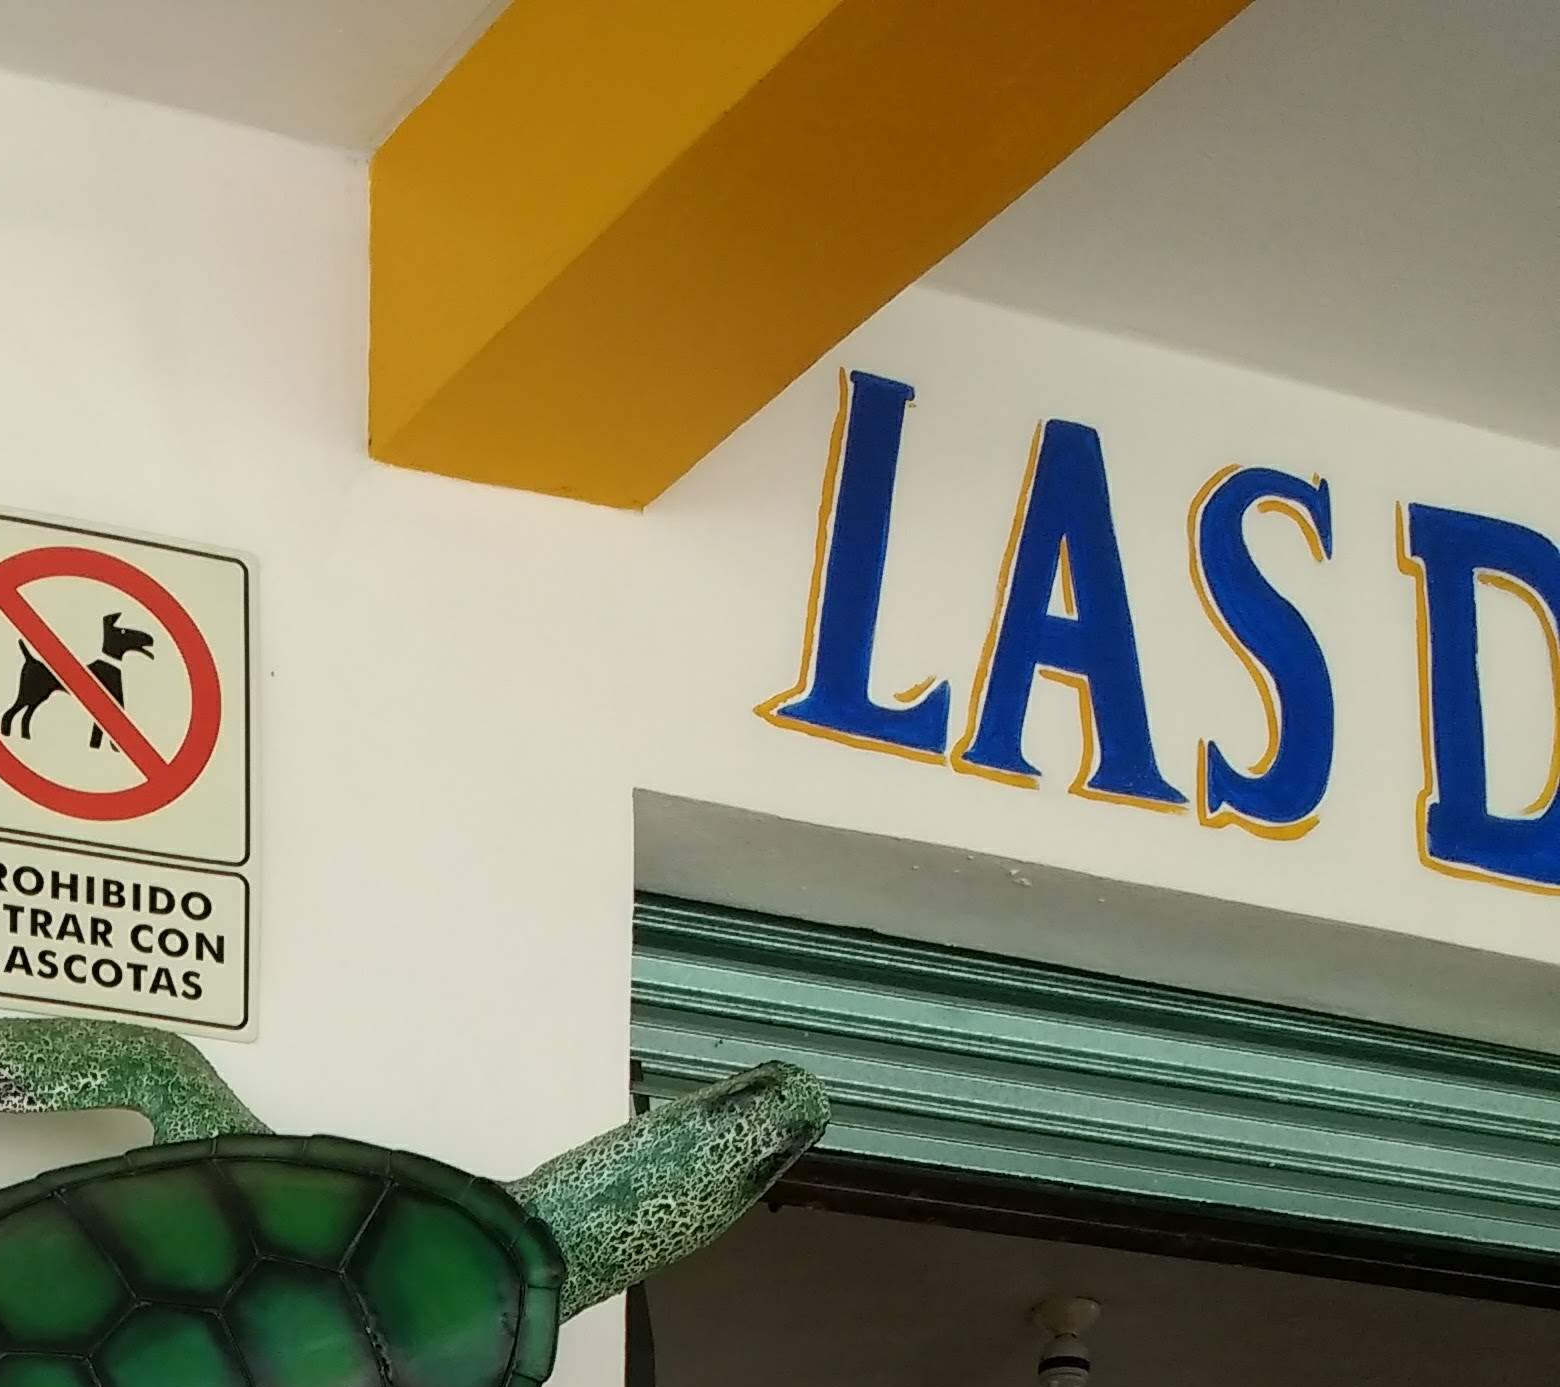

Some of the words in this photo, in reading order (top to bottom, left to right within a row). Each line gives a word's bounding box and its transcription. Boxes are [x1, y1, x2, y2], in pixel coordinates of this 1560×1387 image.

[753, 367, 1336, 841] LAS
[1395, 500, 1560, 896] D
[130, 923, 226, 964] CON
